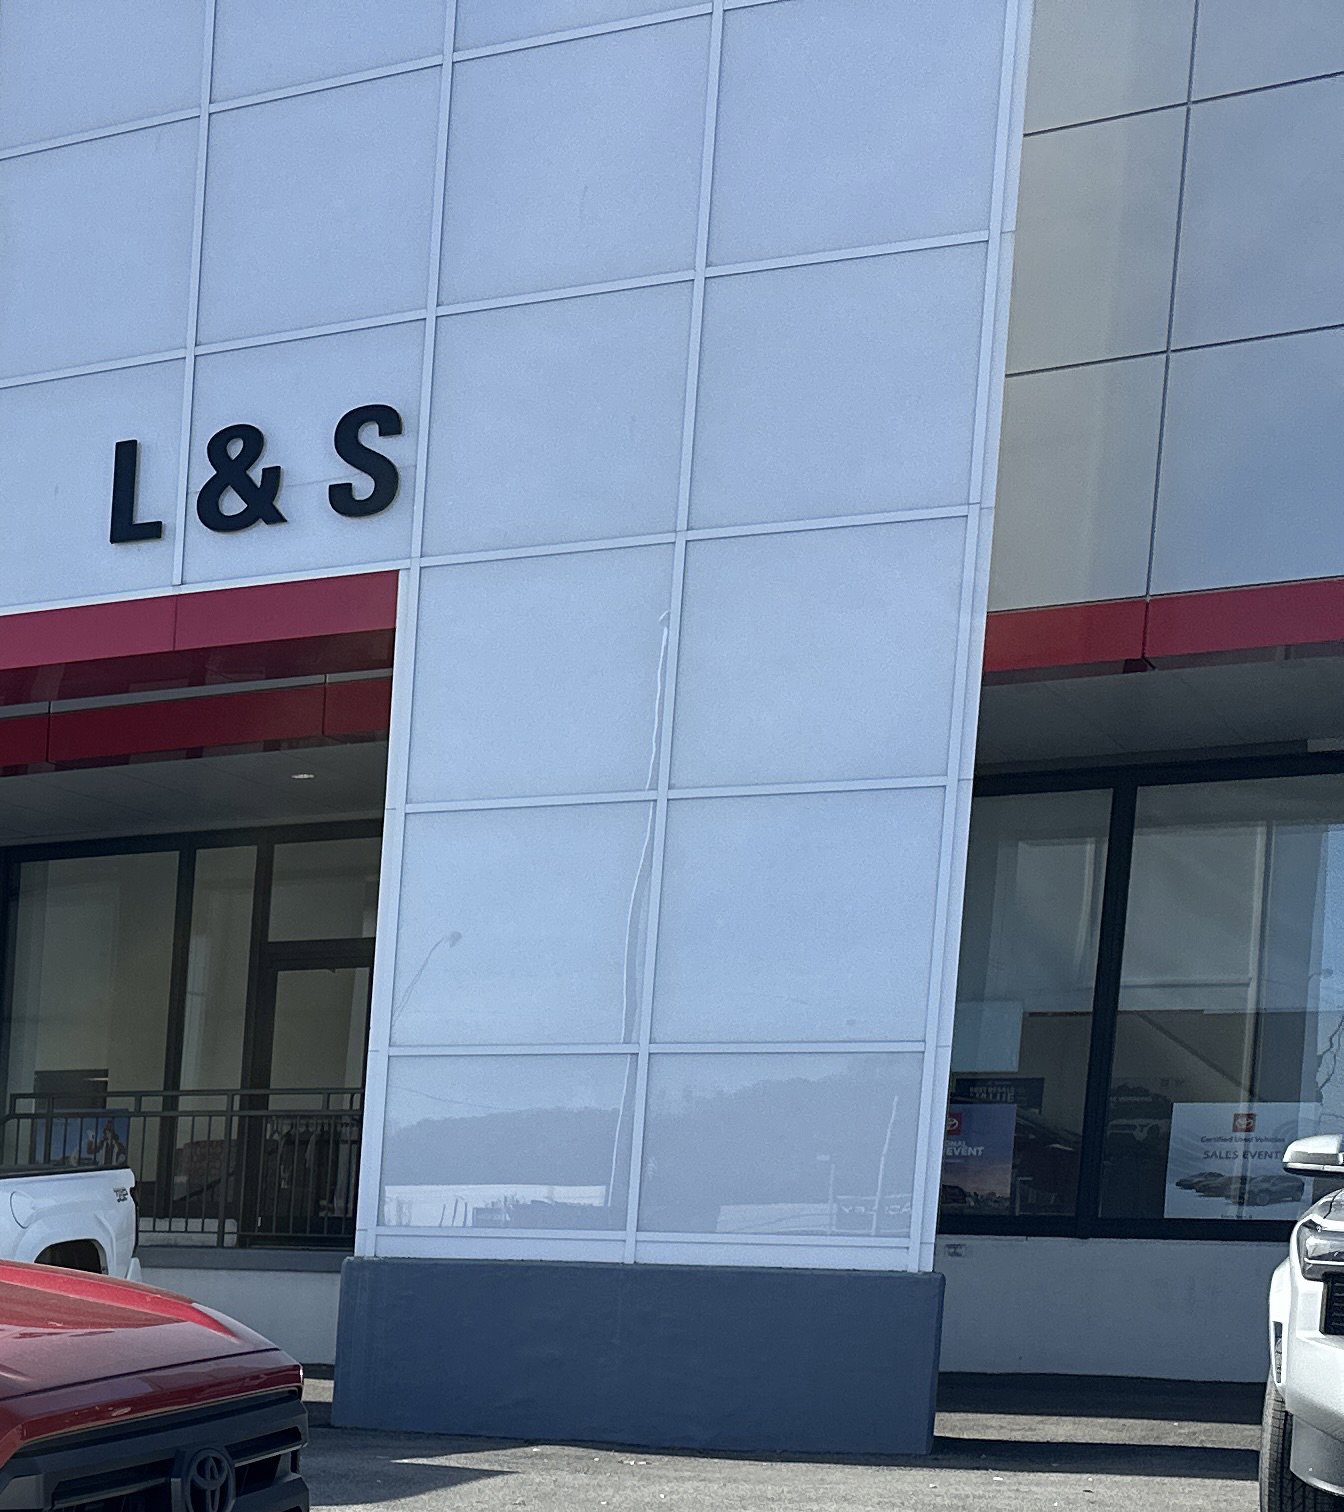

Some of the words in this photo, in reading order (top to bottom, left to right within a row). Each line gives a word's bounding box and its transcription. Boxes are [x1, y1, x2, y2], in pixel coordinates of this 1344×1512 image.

[109, 438, 163, 544] L
[196, 423, 288, 533] &
[328, 403, 403, 517] S
[1202, 1150, 1239, 1159] SALES
[1242, 1150, 1281, 1159] EVENT
